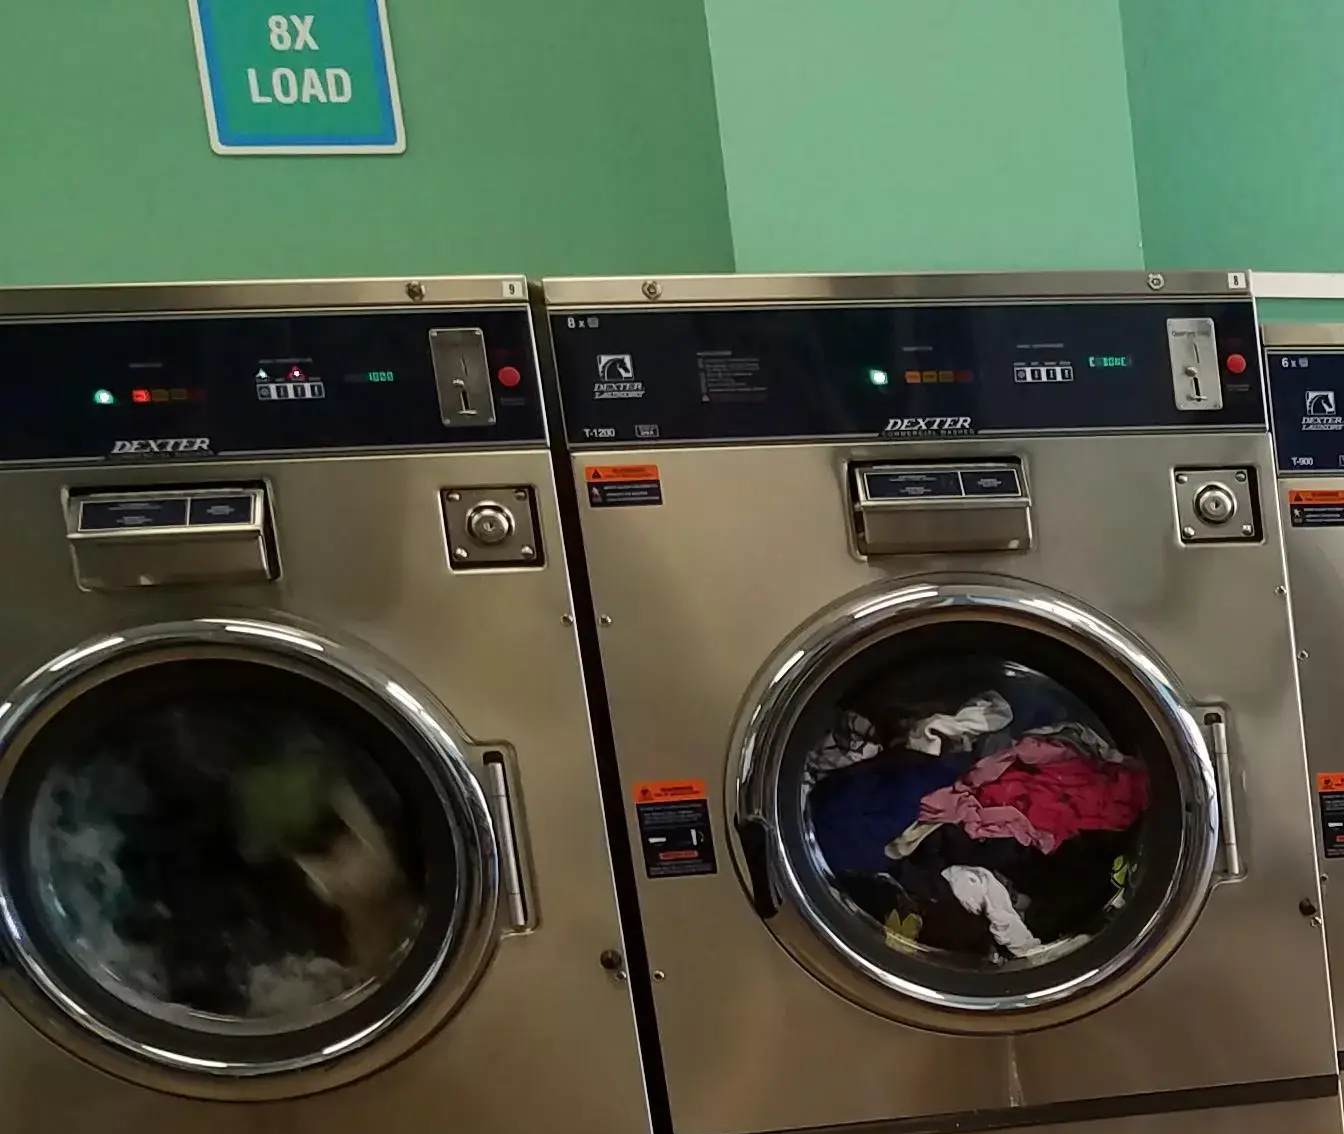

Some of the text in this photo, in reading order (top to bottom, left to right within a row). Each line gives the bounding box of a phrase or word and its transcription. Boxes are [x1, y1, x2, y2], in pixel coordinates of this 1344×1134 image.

[267, 15, 320, 51] 8X
[247, 67, 353, 104] LOAD
[1233, 275, 1239, 286] 8
[508, 284, 515, 295] 9
[1281, 357, 1289, 368] 6
[594, 382, 643, 391] DEXTER
[885, 416, 972, 431] DEXTER
[584, 428, 616, 438] T-1200
[111, 437, 210, 454] DEXTER
